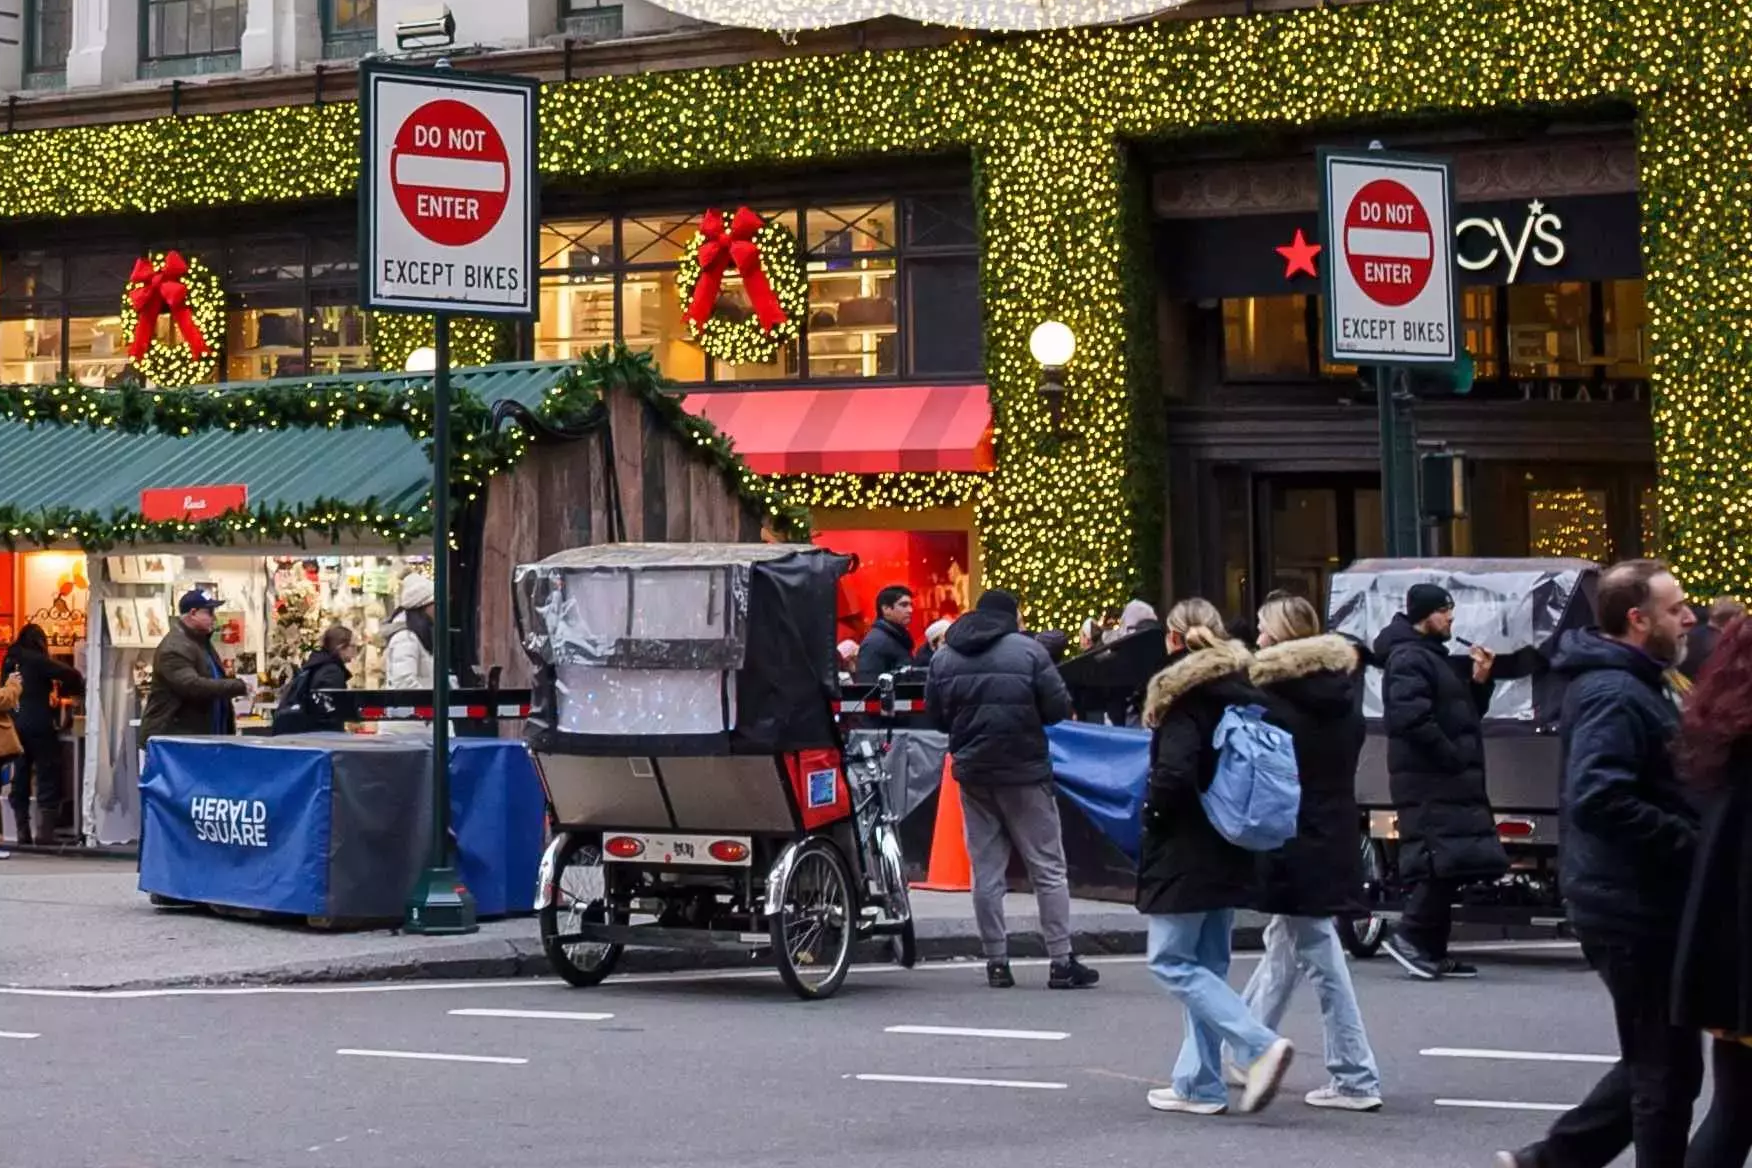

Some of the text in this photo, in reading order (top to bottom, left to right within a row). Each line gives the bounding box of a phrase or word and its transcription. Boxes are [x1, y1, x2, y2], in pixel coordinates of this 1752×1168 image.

[414, 125, 486, 152] DO NOT
[417, 194, 479, 221] ENTER
[1360, 202, 1414, 225] DO NOT
[1454, 198, 1565, 285] cy's
[384, 259, 519, 291] EXCEPT BIKES
[1364, 262, 1413, 284] ENTER
[1342, 317, 1446, 344] EXCEPT BIKES
[191, 796, 267, 824] HERALD
[194, 819, 268, 847] SQUARE
